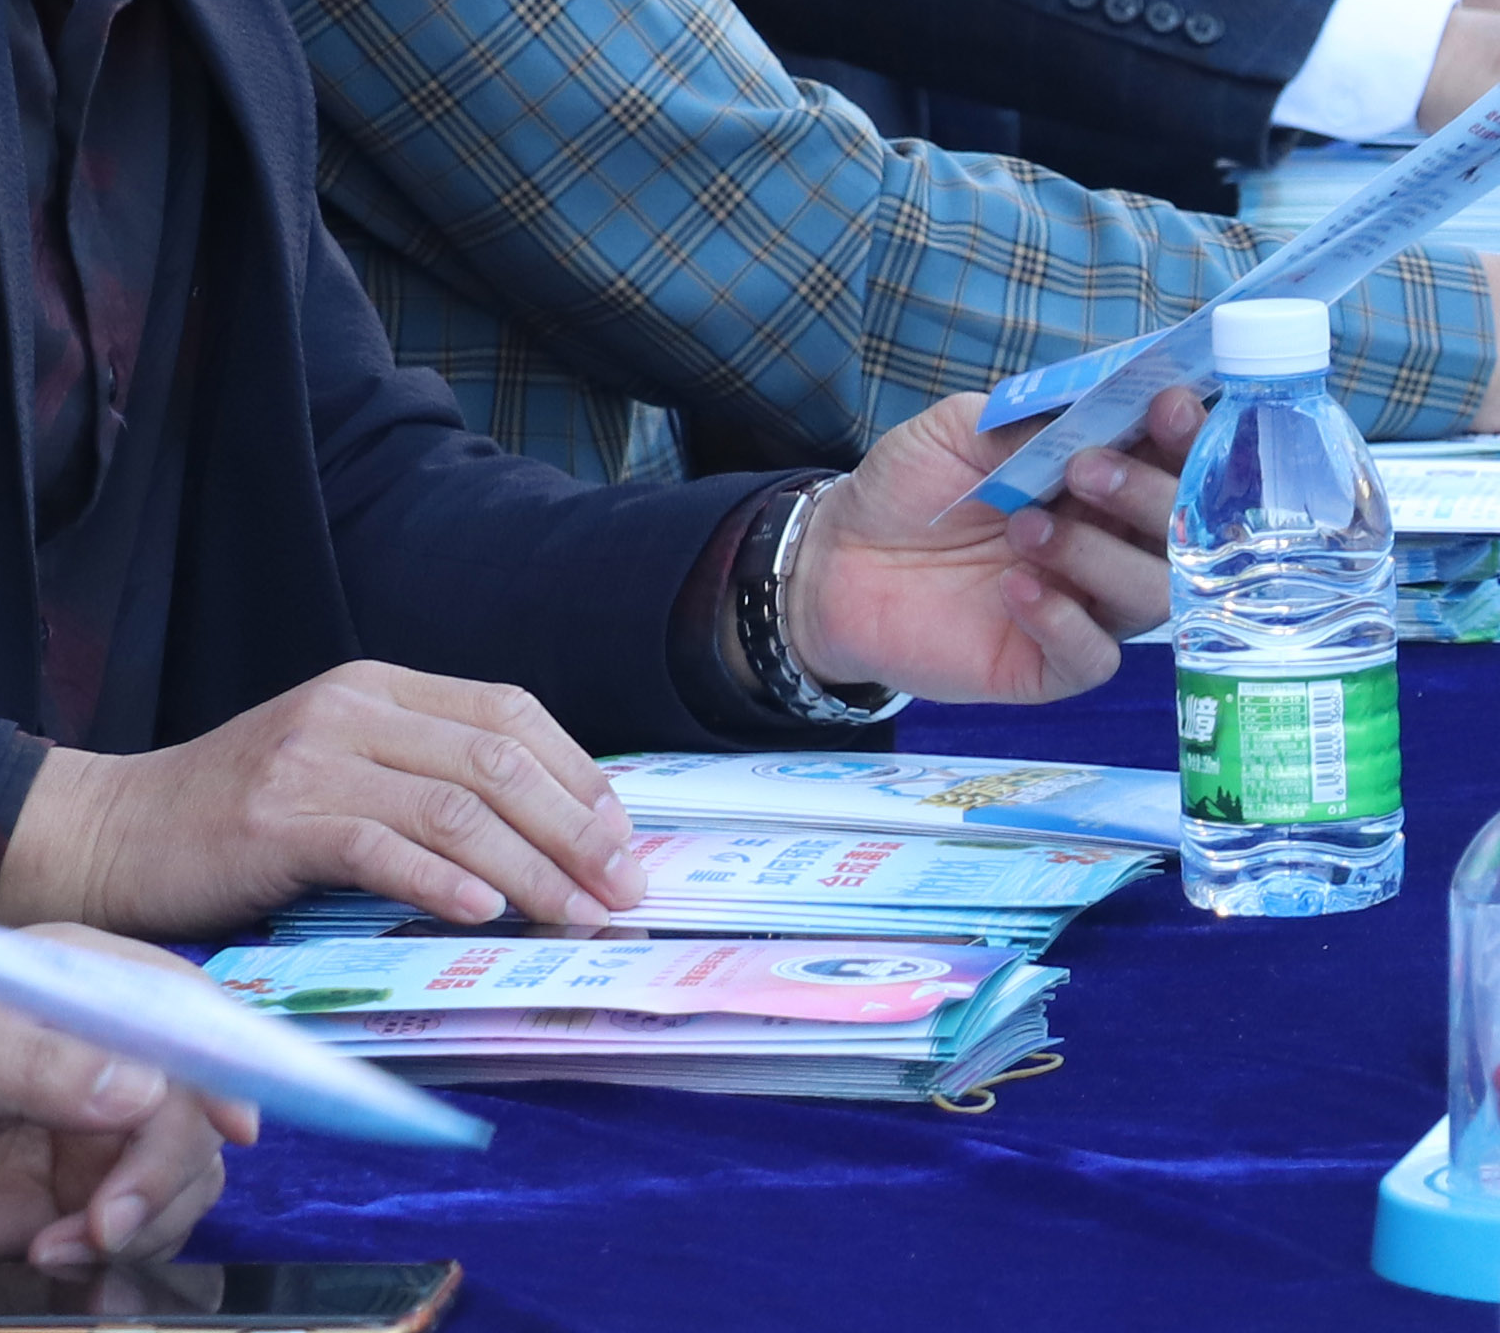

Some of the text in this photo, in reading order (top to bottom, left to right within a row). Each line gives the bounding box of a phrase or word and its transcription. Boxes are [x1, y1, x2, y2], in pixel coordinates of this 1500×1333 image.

[685, 838, 772, 883] 青少年
[817, 840, 905, 889] 合成毒品
[425, 946, 517, 990] 合成毒品
[565, 945, 654, 988] 青少年
